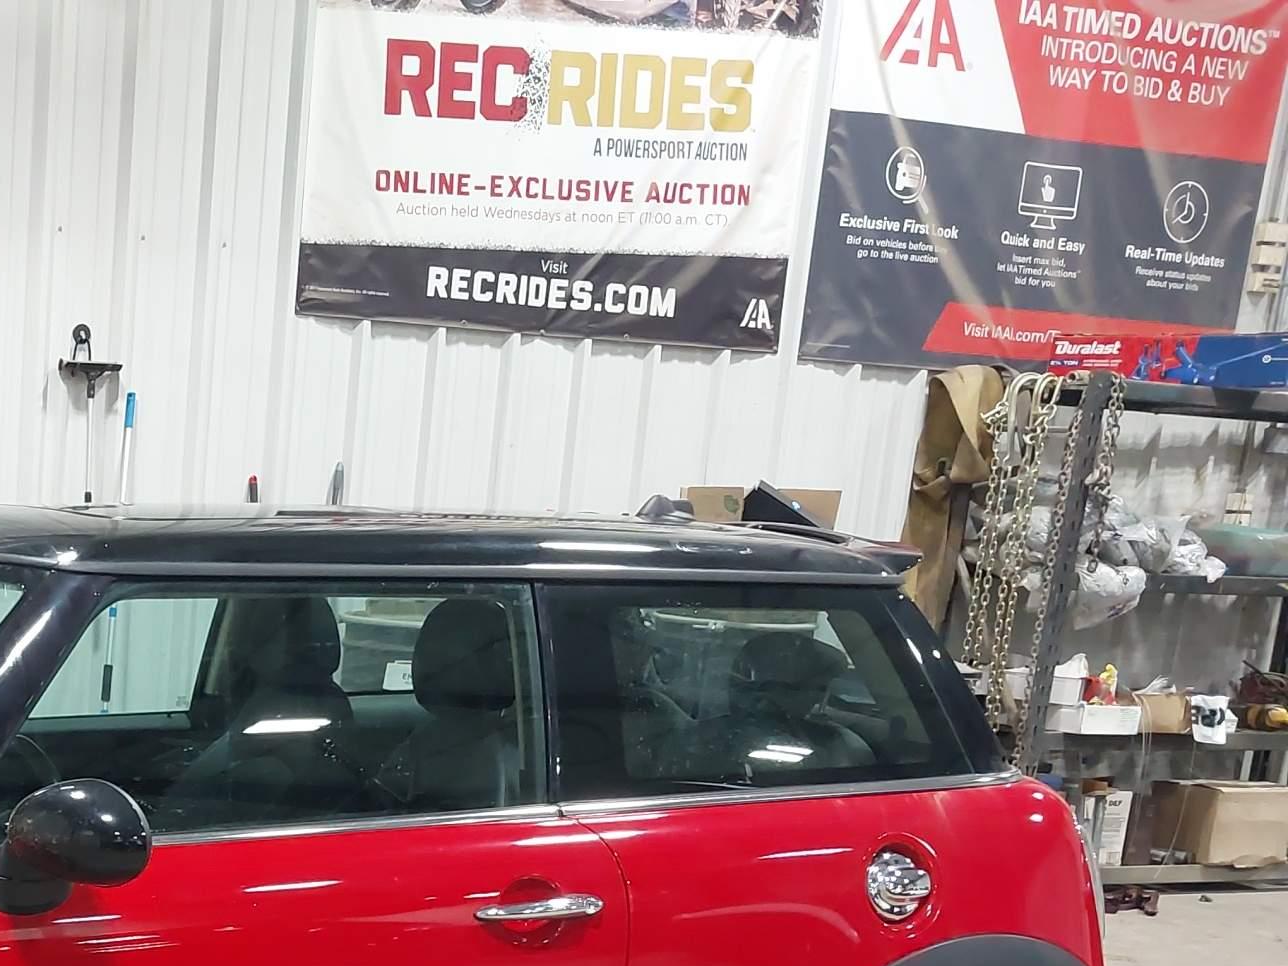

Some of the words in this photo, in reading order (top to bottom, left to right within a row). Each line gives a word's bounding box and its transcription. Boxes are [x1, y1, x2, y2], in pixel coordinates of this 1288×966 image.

[1019, 0, 1057, 30] IAA
[1063, 5, 1141, 40] TIMED
[1041, 34, 1176, 73] INTRODUCING
[1181, 53, 1195, 75] A
[1201, 55, 1249, 81] NEW
[384, 38, 531, 122] REC
[547, 49, 755, 132] RIDES
[1048, 64, 1096, 90] WAY
[1101, 70, 1128, 94] TO
[1133, 75, 1162, 99] BID
[1168, 79, 1182, 102] &
[1188, 82, 1231, 106] BUY
[593, 138, 602, 157] A
[607, 138, 694, 160] POWERSPORT
[694, 140, 748, 161] AUCTION
[375, 169, 634, 203] ONLINE-EXCLUSIVE
[645, 181, 750, 206] AUCTION
[396, 202, 447, 217] Auction
[451, 204, 479, 218] held
[484, 206, 561, 224] Wednesdays
[564, 211, 577, 223] at
[582, 213, 613, 224] noon
[618, 211, 634, 224] ET
[839, 213, 900, 232] Exclusive
[903, 219, 929, 235] First
[932, 224, 959, 239] Look
[846, 235, 861, 245] Bid
[863, 238, 874, 246] on
[876, 238, 907, 250] vehicles
[908, 241, 933, 252] before
[1000, 230, 1030, 247] Quick
[1032, 237, 1055, 250] and
[1057, 237, 1086, 255] Easy
[540, 259, 569, 274] Visit
[857, 249, 868, 259] go
[870, 249, 879, 258] to
[881, 249, 894, 260] the
[895, 251, 908, 261] live
[910, 253, 939, 264] auction
[1125, 244, 1182, 263] Real-Time
[1184, 251, 1225, 268] Updates
[426, 265, 676, 318] RECRIDES.COM
[1014, 276, 1027, 286] bid
[1028, 277, 1040, 287] for
[1040, 279, 1056, 288] you
[963, 321, 990, 338] Visit
[1055, 340, 1122, 355] Duralast
